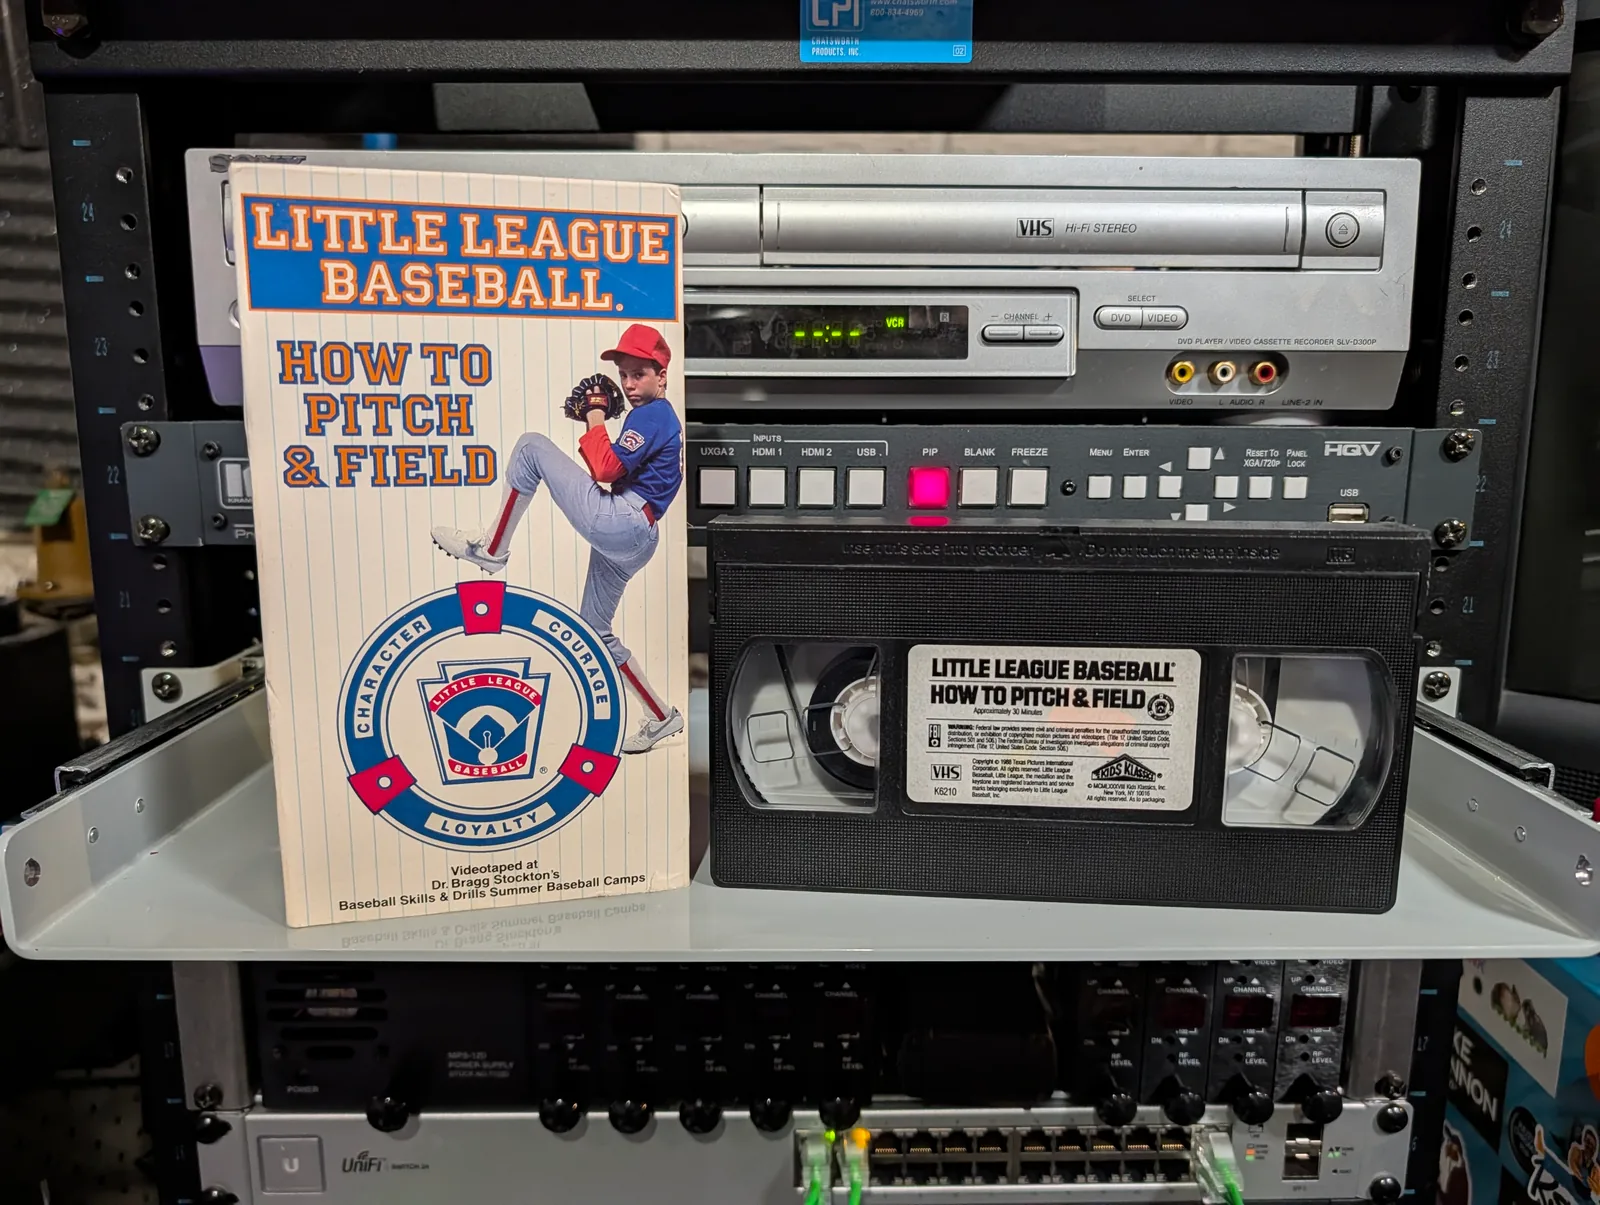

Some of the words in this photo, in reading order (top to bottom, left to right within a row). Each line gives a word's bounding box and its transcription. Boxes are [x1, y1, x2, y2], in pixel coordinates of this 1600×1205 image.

[812, 37, 859, 45] CHATSWORTH
[955, 47, 964, 55] 02
[81, 202, 95, 222] 24
[251, 203, 448, 256] LITTLE
[460, 213, 670, 264] LEAGUE
[1019, 219, 1052, 236] VHS
[1065, 223, 1090, 233] Hi-Fi
[1094, 223, 1137, 234] STEREO
[886, 317, 904, 328] VCR
[1111, 313, 1131, 323] DVD
[1147, 313, 1178, 323] VIDEO
[95, 337, 108, 356] 23
[277, 340, 412, 386] HOW
[421, 342, 492, 387] TO
[304, 393, 474, 436] PITCH
[701, 448, 728, 456] UXGA
[728, 448, 735, 456] 2
[752, 448, 776, 456] HDMI
[778, 448, 783, 456] 1
[801, 448, 825, 456] HDMI
[826, 448, 832, 456] 2
[857, 448, 876, 456] USB
[922, 448, 938, 457] PIP
[964, 448, 995, 457] BLANK
[1012, 448, 1048, 457] FREEZE
[1089, 448, 1113, 457] MENU
[1123, 449, 1150, 457] ENTER
[1324, 443, 1381, 457] HQV
[284, 445, 329, 488] &
[334, 445, 498, 487] FIELD
[1287, 459, 1306, 468] LOCK
[107, 466, 120, 484] 22
[1340, 489, 1359, 497] USB
[120, 591, 130, 609] 21
[1463, 596, 1474, 613] 21
[549, 621, 608, 704] COURAGE
[932, 658, 990, 678] LITTLE
[995, 659, 1070, 680] LEAGUE
[357, 619, 427, 733] CHARACTER
[433, 678, 476, 706] LITTLE
[488, 677, 538, 700] LEAGUE
[931, 685, 979, 704] HOW
[981, 685, 1007, 705] TO
[1011, 686, 1069, 707] PITCH
[1072, 687, 1091, 708] &
[1092, 688, 1146, 709] FIELD
[973, 707, 1011, 716] Approximately
[454, 760, 523, 775] BASEBALL
[933, 766, 960, 779] VHS
[1101, 763, 1122, 779] KIDS
[934, 787, 957, 796] K6210
[441, 812, 538, 835] LOYALTY
[451, 861, 523, 877] Videotaped
[526, 859, 538, 870] at
[431, 878, 449, 890] Dr.
[451, 876, 490, 889] Bragg
[493, 869, 560, 885] Stockton's
[339, 896, 397, 911] Baseball
[400, 893, 436, 906] Skills
[439, 891, 449, 902] &
[453, 888, 486, 901] Drills
[490, 884, 543, 898] Summer
[546, 877, 600, 892] Baseball
[603, 873, 646, 887] Camps
